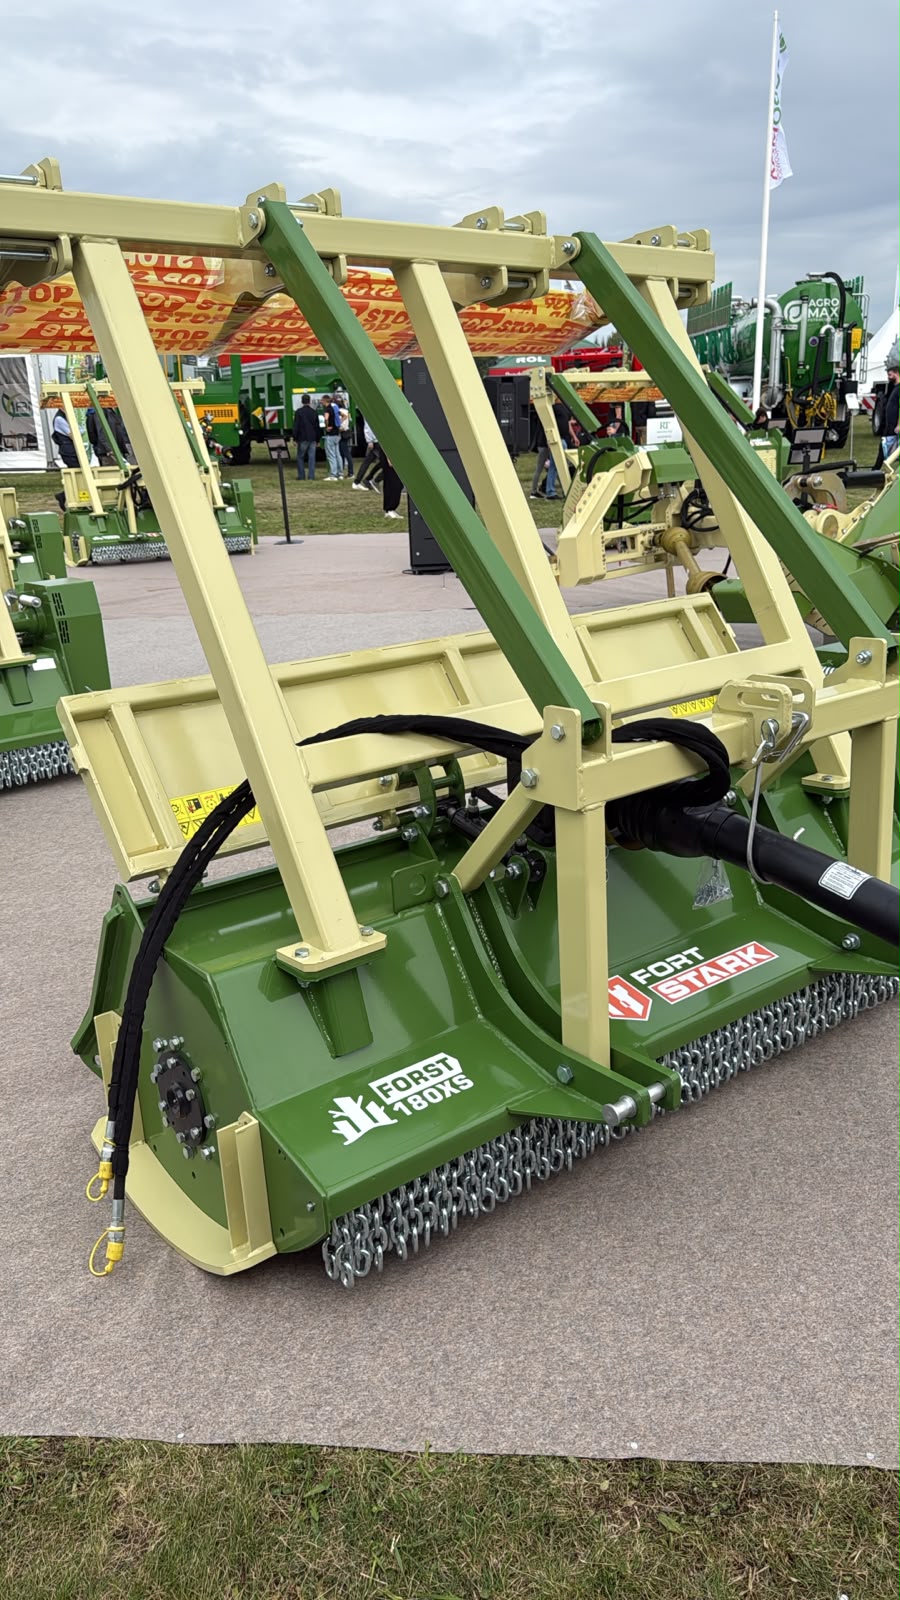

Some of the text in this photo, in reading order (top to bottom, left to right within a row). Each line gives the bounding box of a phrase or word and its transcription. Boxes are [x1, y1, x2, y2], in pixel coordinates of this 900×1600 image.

[808, 307, 839, 318] MAX
[809, 298, 839, 307] AGRO
[232, 333, 299, 345] STOP
[496, 320, 548, 334] STOP
[630, 946, 705, 985] FORT
[656, 945, 773, 1000] STARK
[376, 1057, 454, 1099] FORST
[393, 1074, 474, 1117] 180XS
